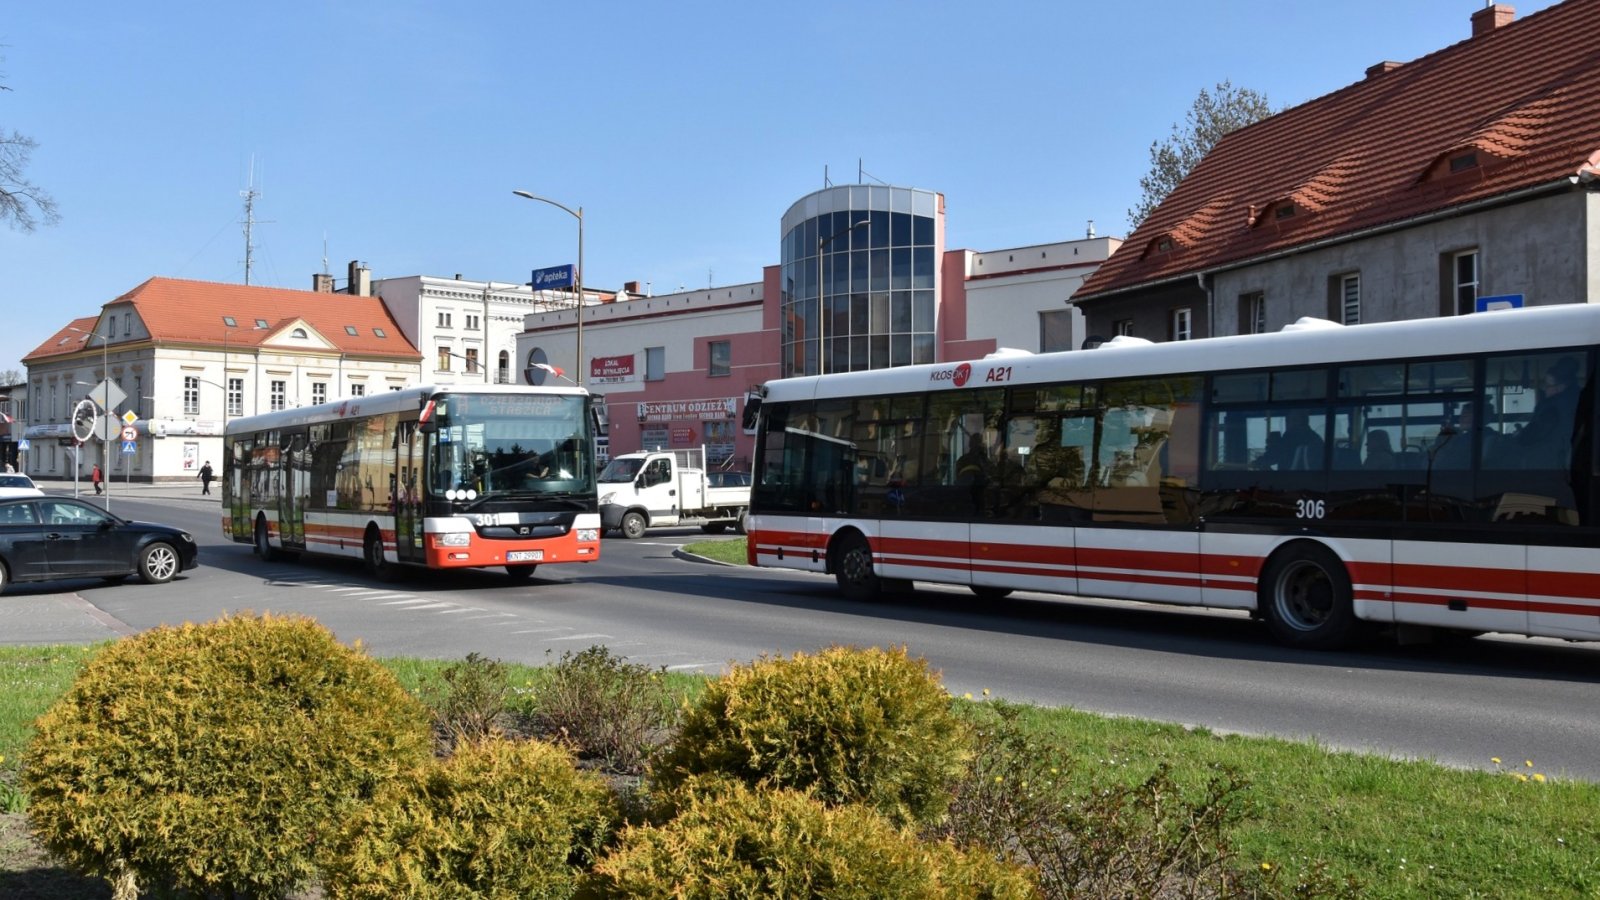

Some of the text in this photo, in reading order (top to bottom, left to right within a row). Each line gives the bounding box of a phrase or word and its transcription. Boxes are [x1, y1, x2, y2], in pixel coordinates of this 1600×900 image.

[543, 271, 567, 284] apteka
[985, 366, 1012, 382] A21
[645, 400, 728, 414] CENTRUM ODZIEŻY
[1296, 499, 1325, 519] 306
[476, 513, 500, 526] 301
